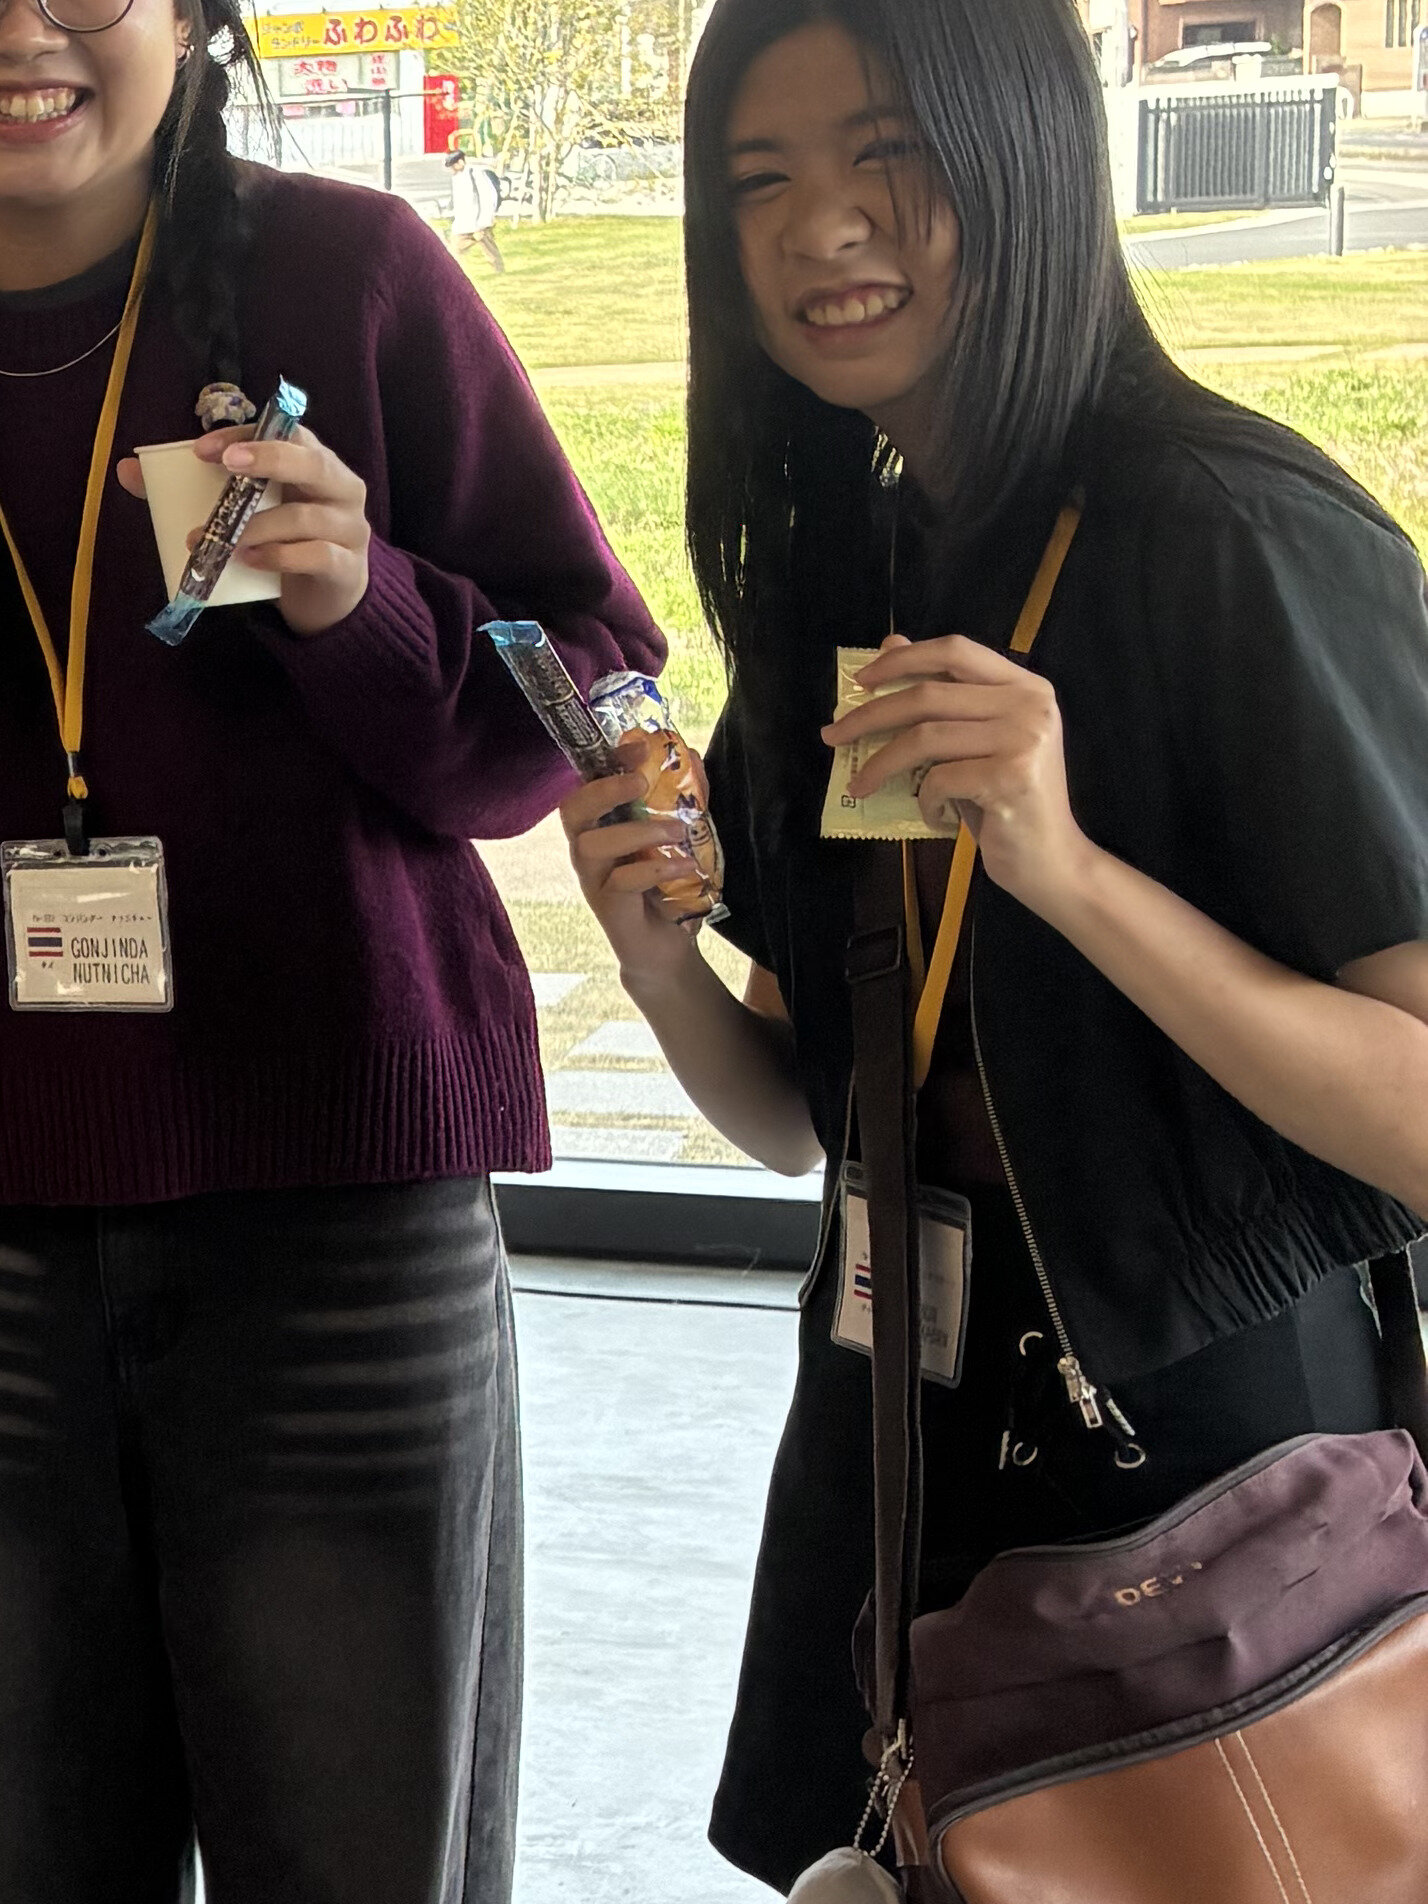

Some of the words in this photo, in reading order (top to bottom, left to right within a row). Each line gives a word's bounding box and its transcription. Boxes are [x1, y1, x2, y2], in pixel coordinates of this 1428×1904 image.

[323, 14, 441, 46] ふわふわ
[71, 937, 149, 959] GONJINDA
[73, 963, 151, 985] NUTNICHA
